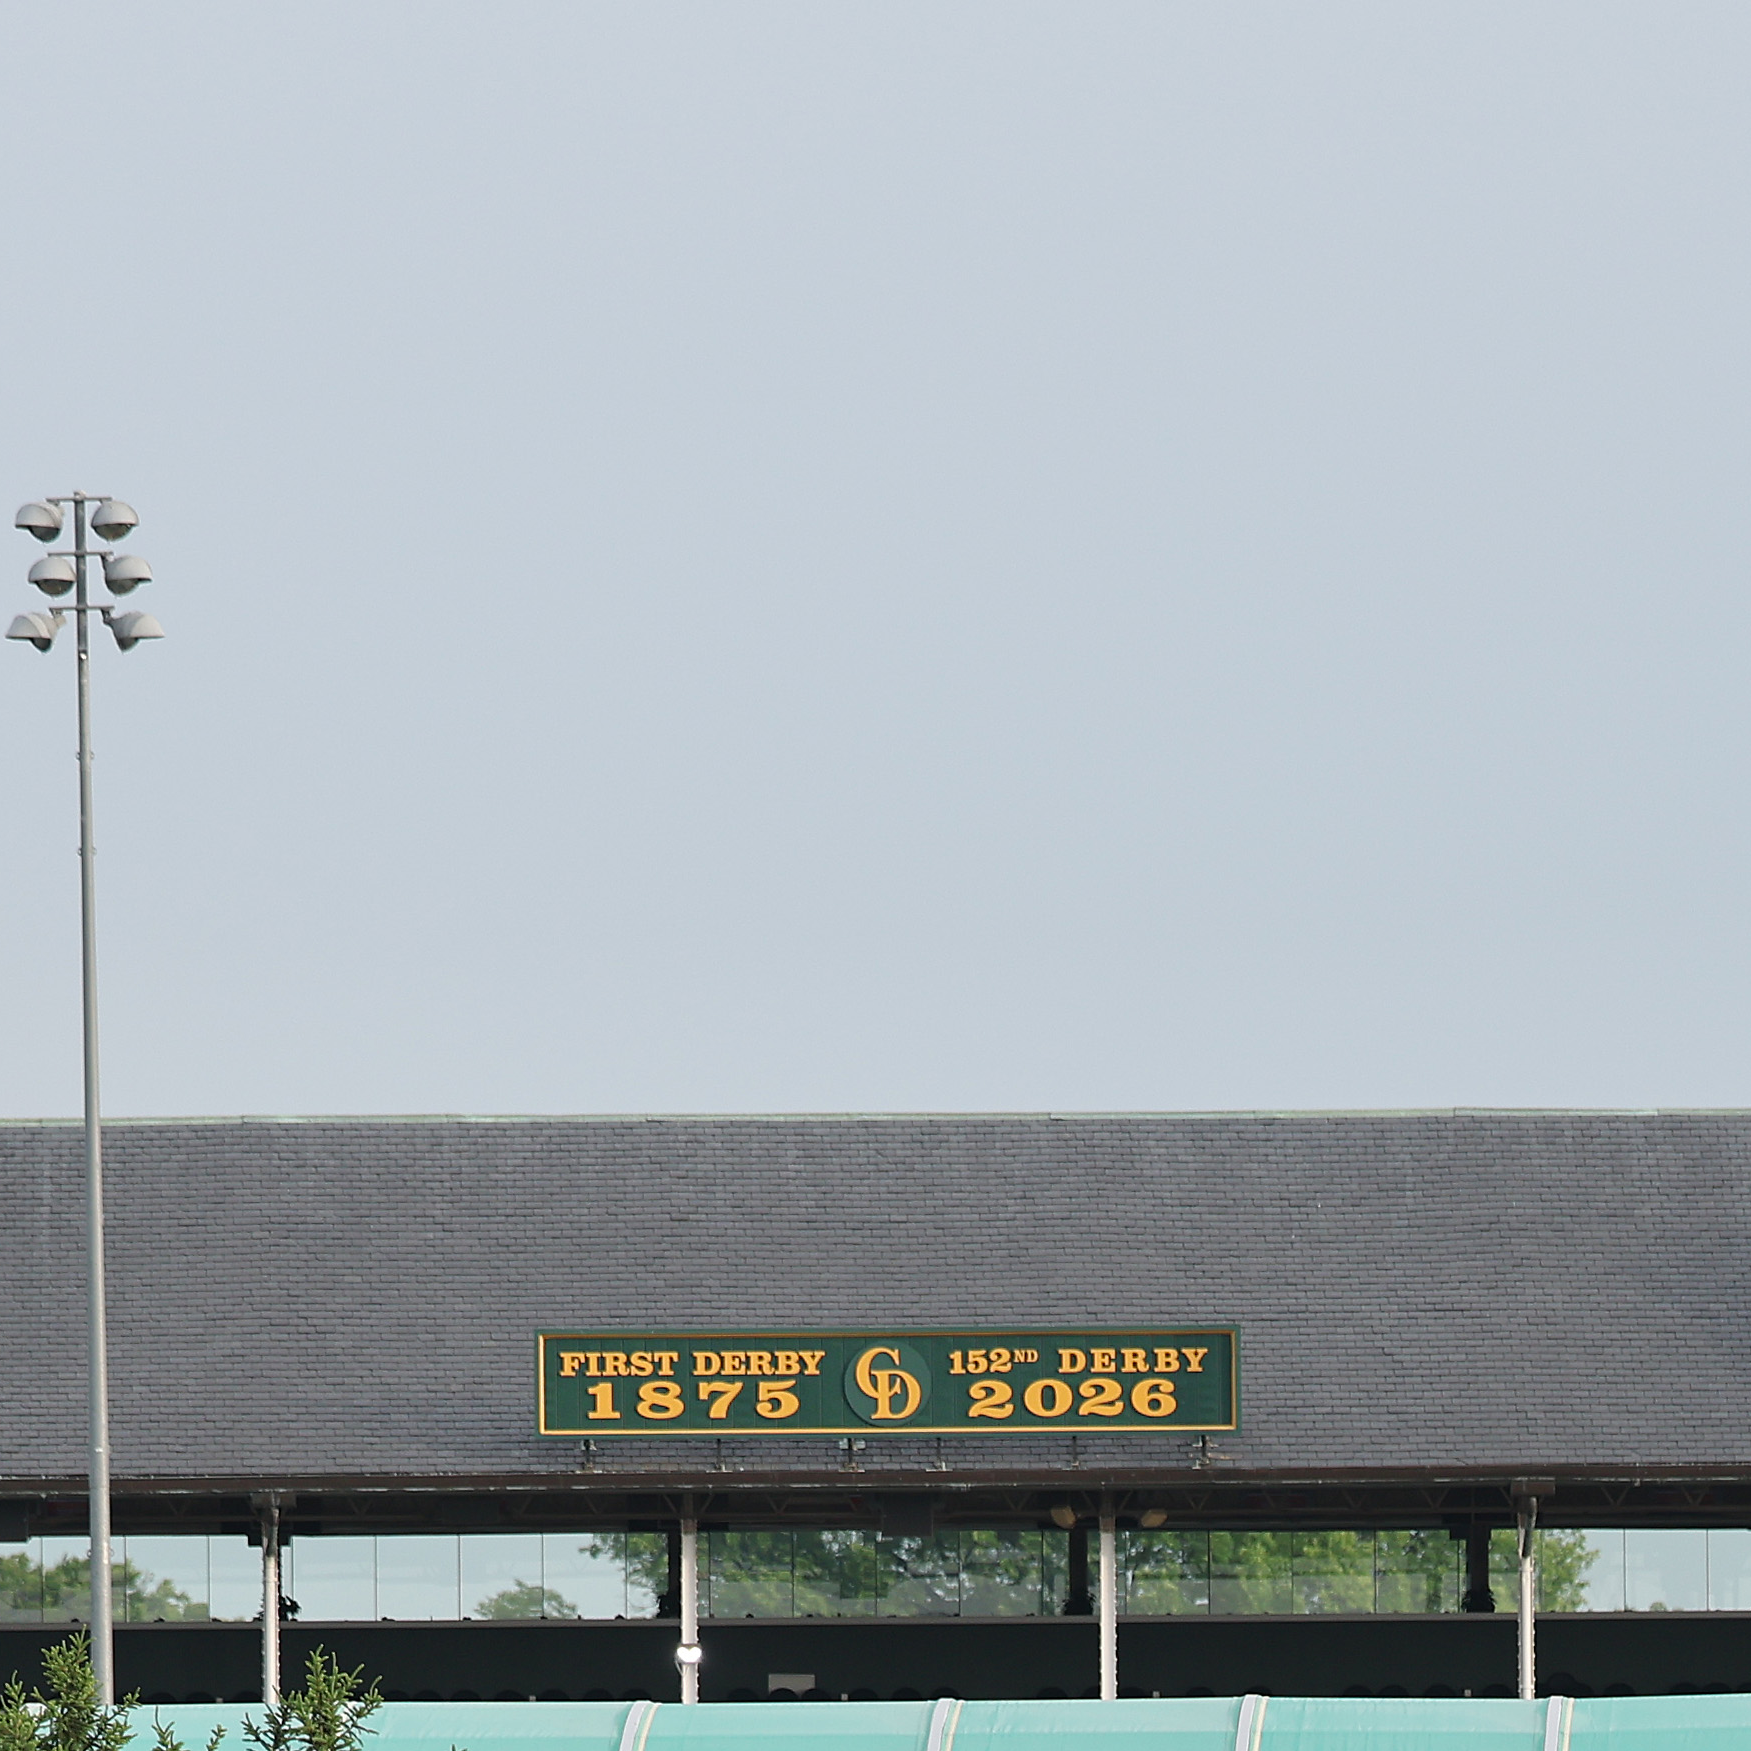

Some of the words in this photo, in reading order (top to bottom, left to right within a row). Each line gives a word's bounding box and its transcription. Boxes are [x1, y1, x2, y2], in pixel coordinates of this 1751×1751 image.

[558, 1351, 679, 1377] FIRST
[692, 1350, 826, 1376] DERBY
[948, 1347, 1039, 1375] 152ND
[1057, 1347, 1209, 1374] DERBY
[586, 1379, 801, 1420] 1875
[967, 1376, 1178, 1420] 2026
